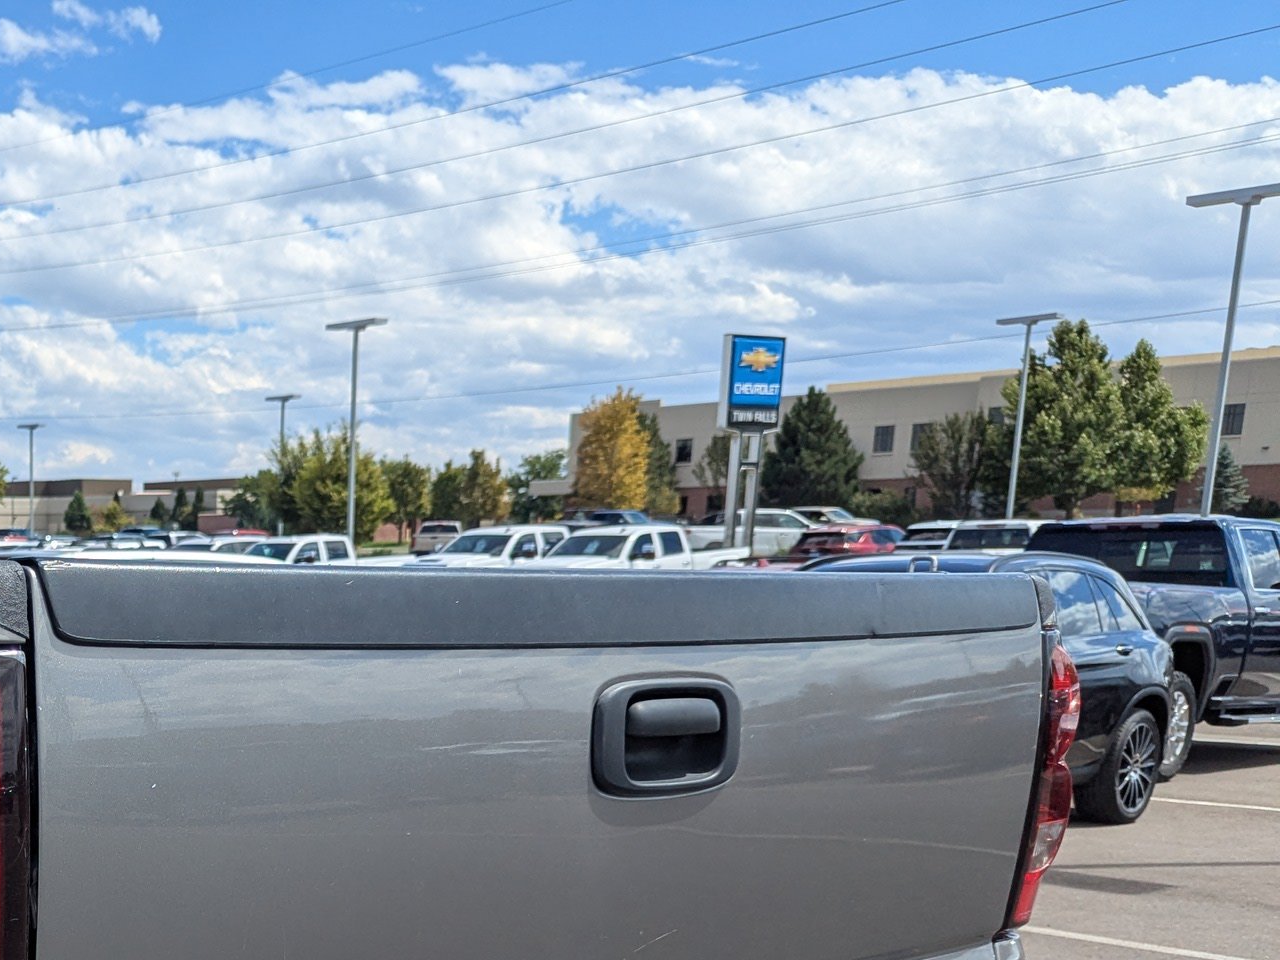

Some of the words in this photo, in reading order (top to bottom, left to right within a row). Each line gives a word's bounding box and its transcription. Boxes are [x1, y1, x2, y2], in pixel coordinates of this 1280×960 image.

[733, 382, 780, 395] CHEVROLET
[732, 409, 753, 422] TWIN
[754, 410, 777, 423] FALLS
